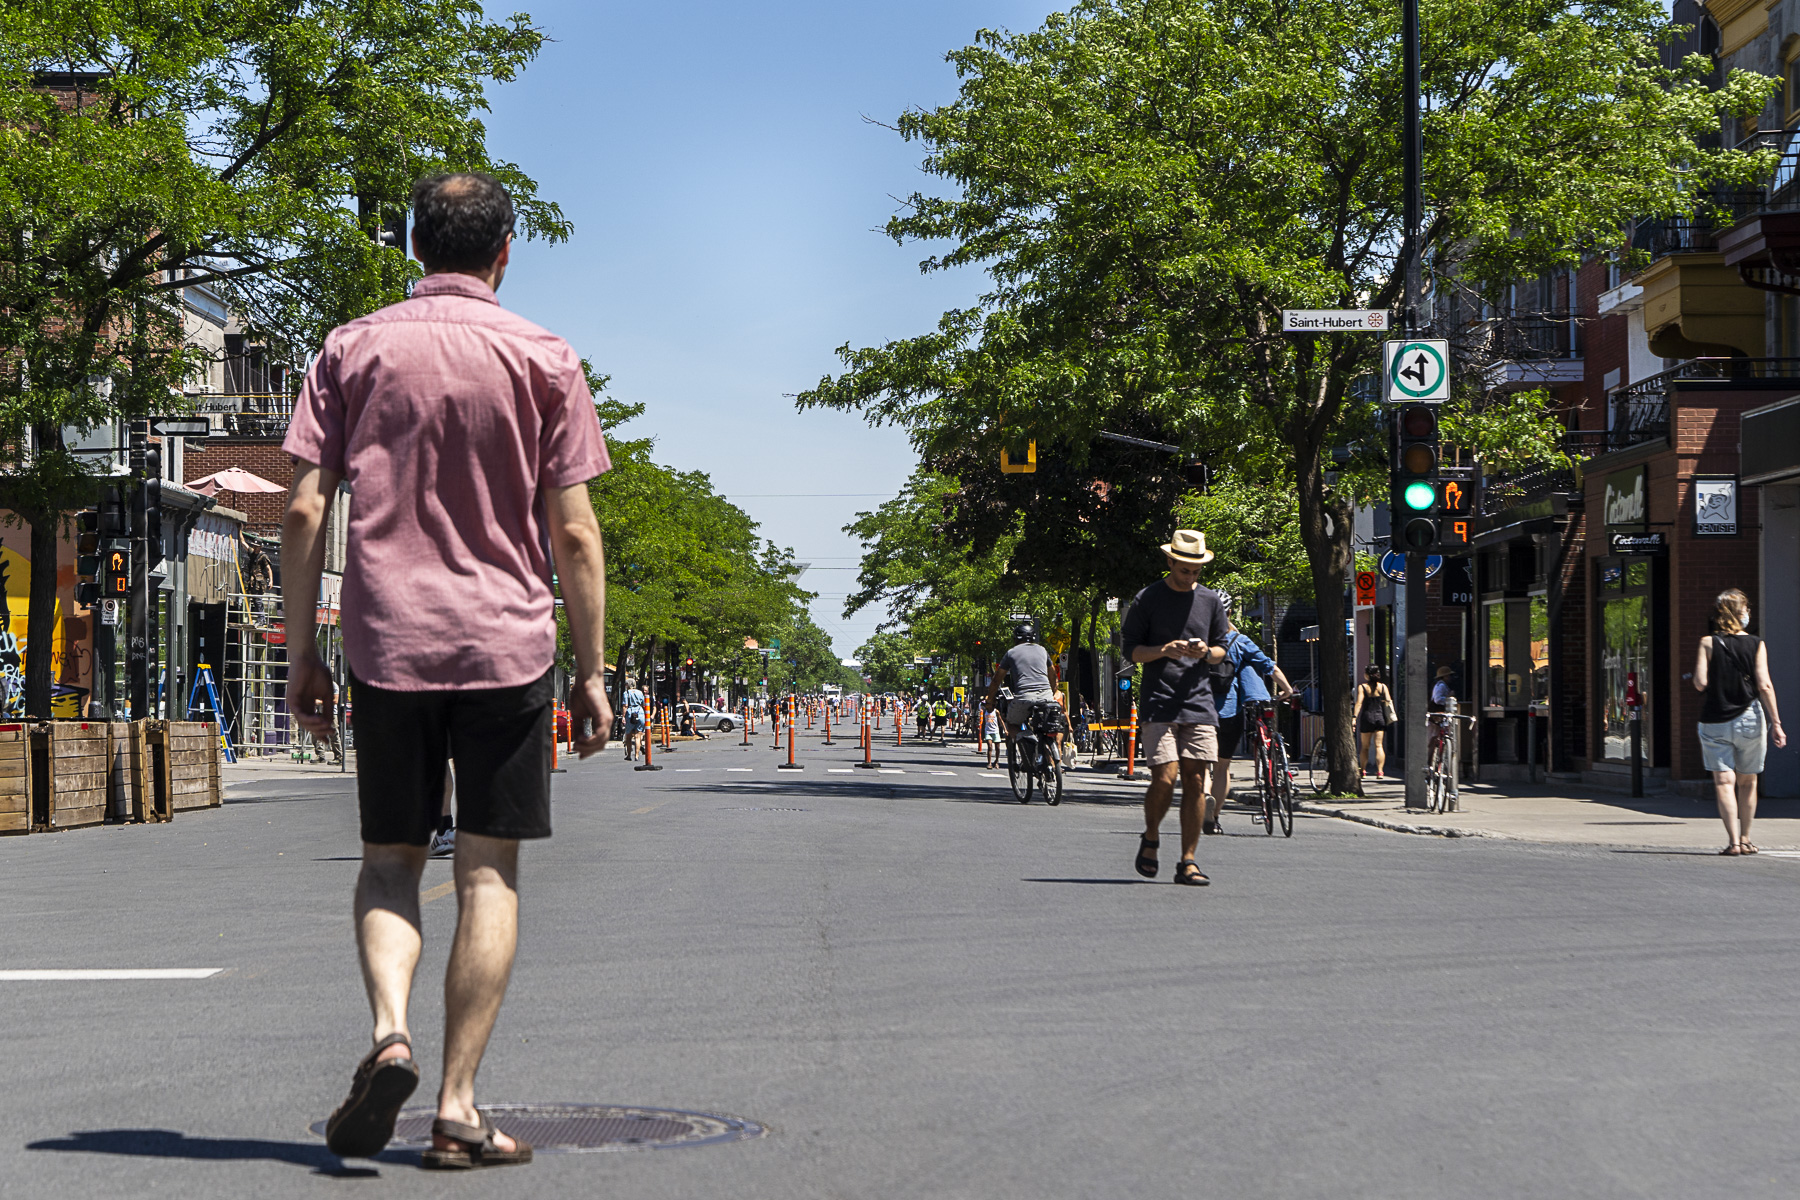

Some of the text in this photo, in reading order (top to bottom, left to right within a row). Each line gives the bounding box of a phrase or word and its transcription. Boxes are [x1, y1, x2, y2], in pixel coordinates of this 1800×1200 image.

[1289, 317, 1363, 328] Saint-Hubert
[1453, 521, 1467, 543] 9
[1698, 523, 1735, 533] DENTISTE
[116, 577, 126, 592] 0
